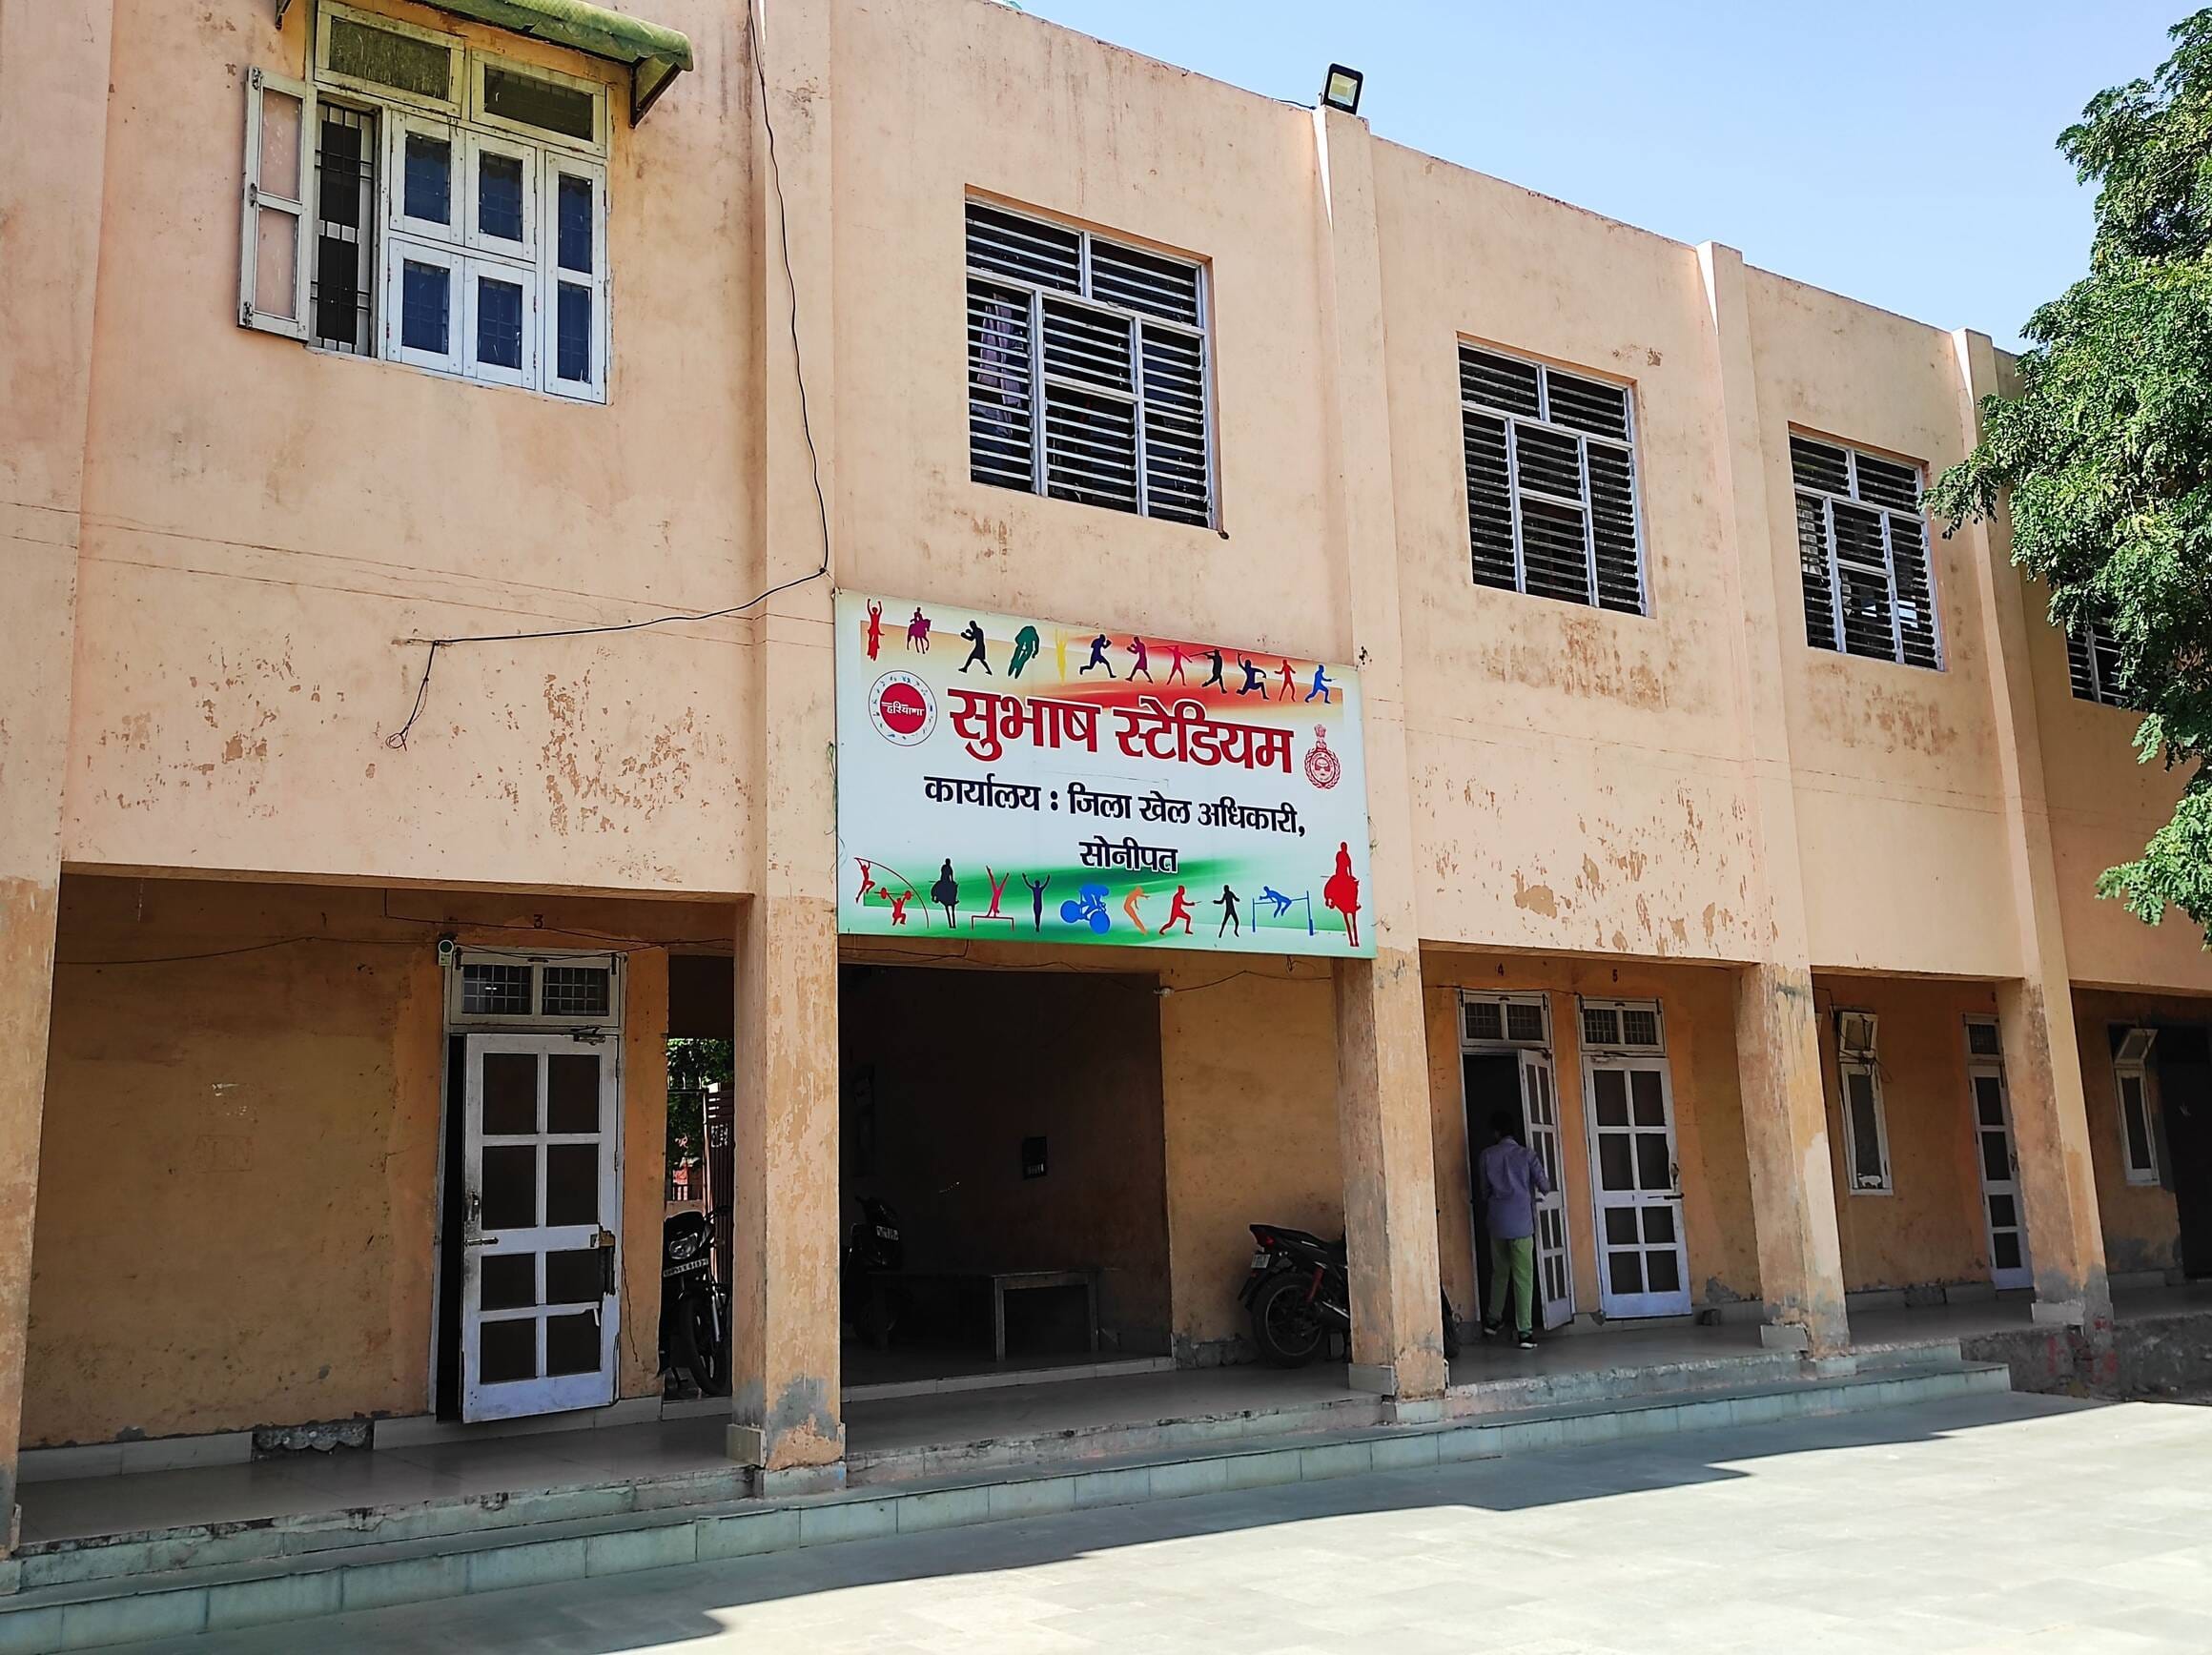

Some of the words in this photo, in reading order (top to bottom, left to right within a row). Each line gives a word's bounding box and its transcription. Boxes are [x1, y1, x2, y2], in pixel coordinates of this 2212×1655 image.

[881, 700, 925, 716] हरियाणा
[948, 688, 1100, 762] सुभाष
[1113, 696, 1294, 774] स्टेडियम
[924, 772, 1040, 810] कार्यालय
[1067, 782, 1132, 820] जिला
[1138, 790, 1192, 826] खेल
[1198, 796, 1306, 837] अधिकारी,
[1078, 835, 1179, 873] सोनीपत
[533, 913, 543, 929] 3
[1497, 963, 1505, 976] 4
